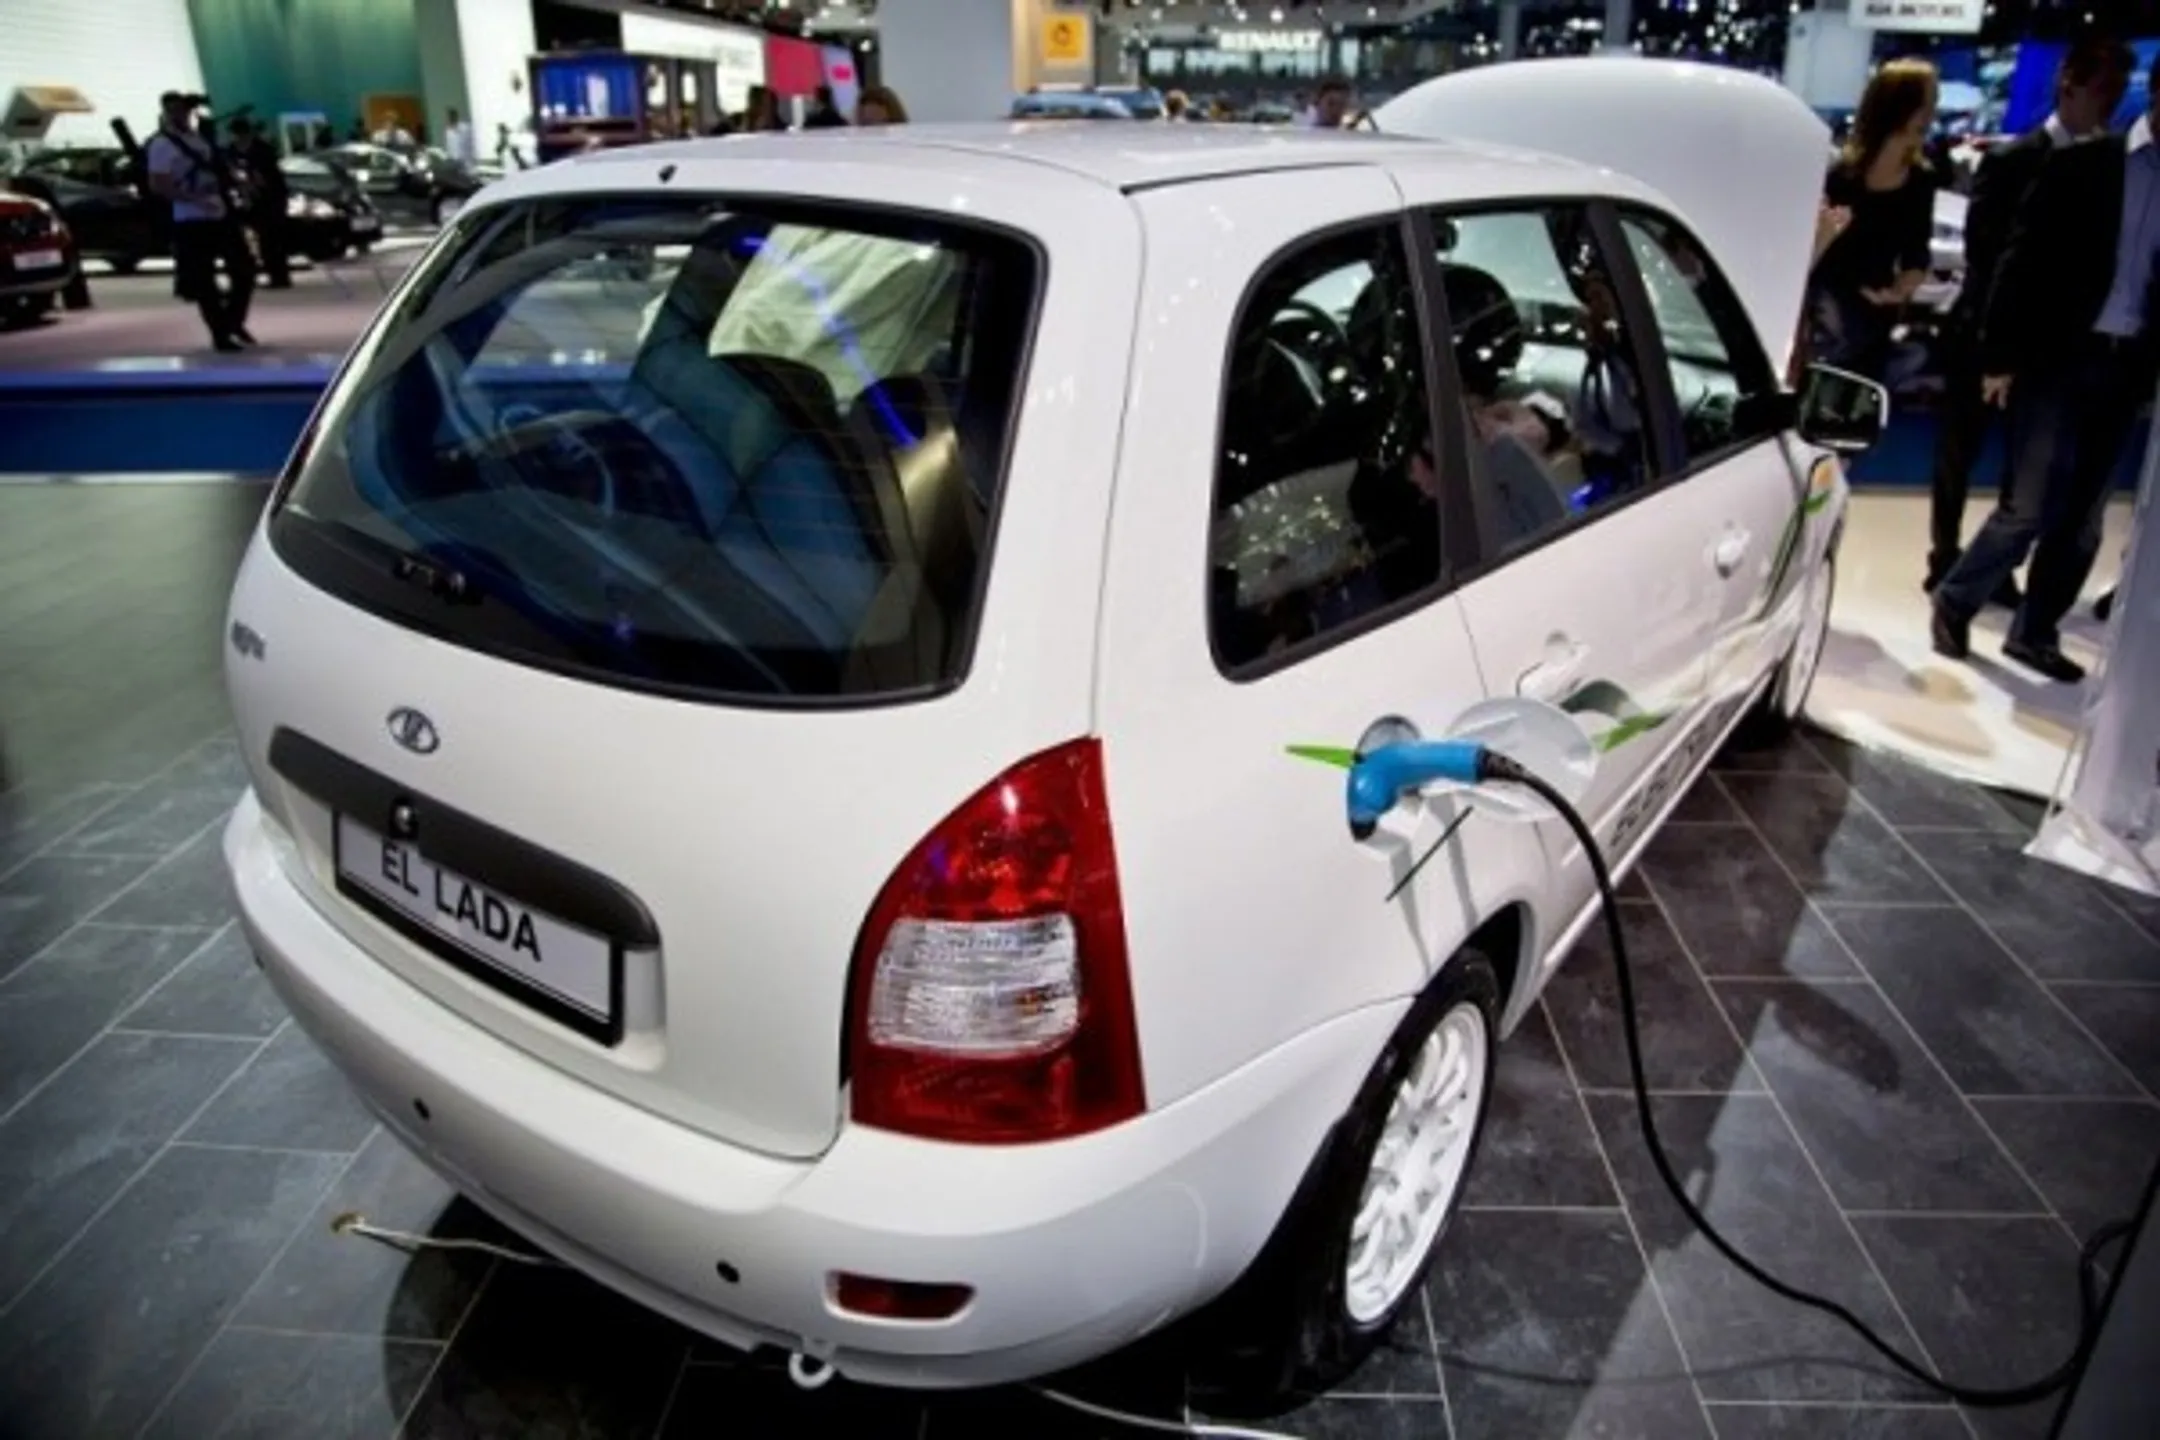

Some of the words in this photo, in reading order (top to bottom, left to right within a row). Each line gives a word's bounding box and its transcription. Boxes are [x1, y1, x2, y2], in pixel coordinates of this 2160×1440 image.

[1219, 31, 1322, 51] RENAULT
[381, 840, 420, 897] EL
[434, 867, 542, 963] LADA
